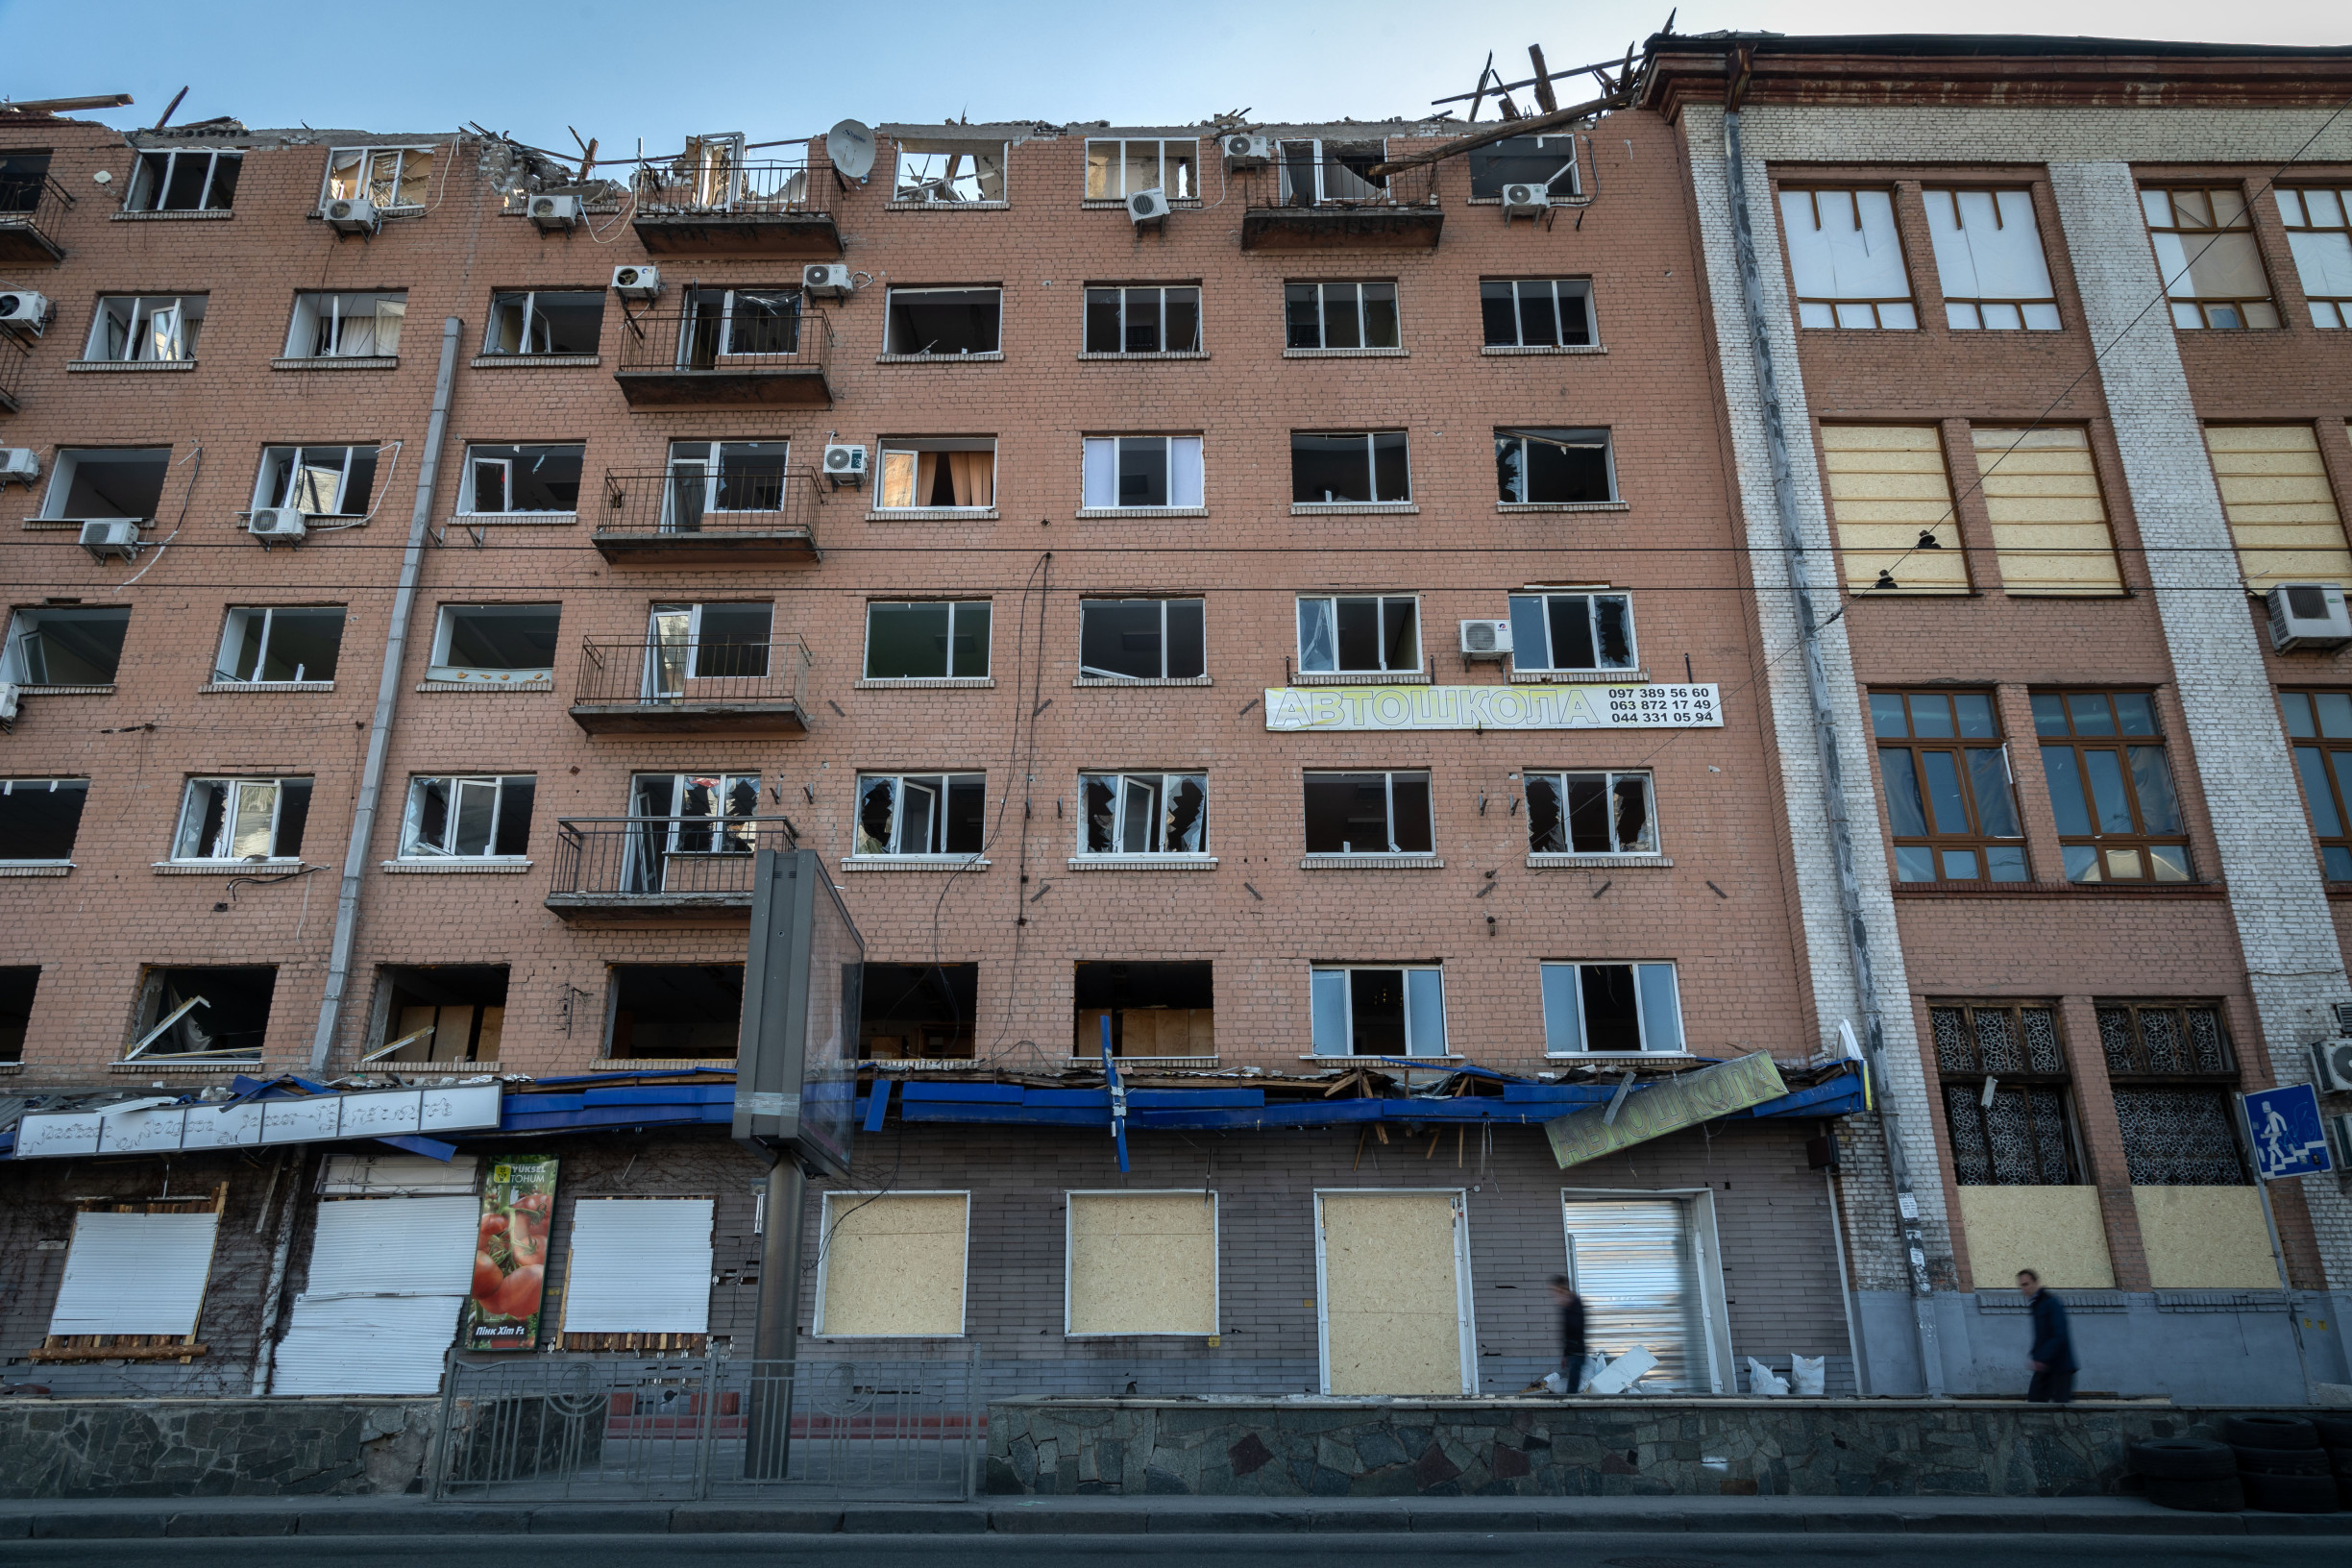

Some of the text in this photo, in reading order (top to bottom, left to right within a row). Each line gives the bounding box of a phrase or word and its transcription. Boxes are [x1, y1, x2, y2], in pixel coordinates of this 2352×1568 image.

[1608, 688, 1709, 698] 097 389 56 60
[1273, 690, 1600, 725] АВТОШКОЛА
[1610, 700, 1711, 710] 063 872 17 49
[1611, 713, 1713, 723] 044 331 05 94
[512, 1164, 546, 1173] YÜKSEL
